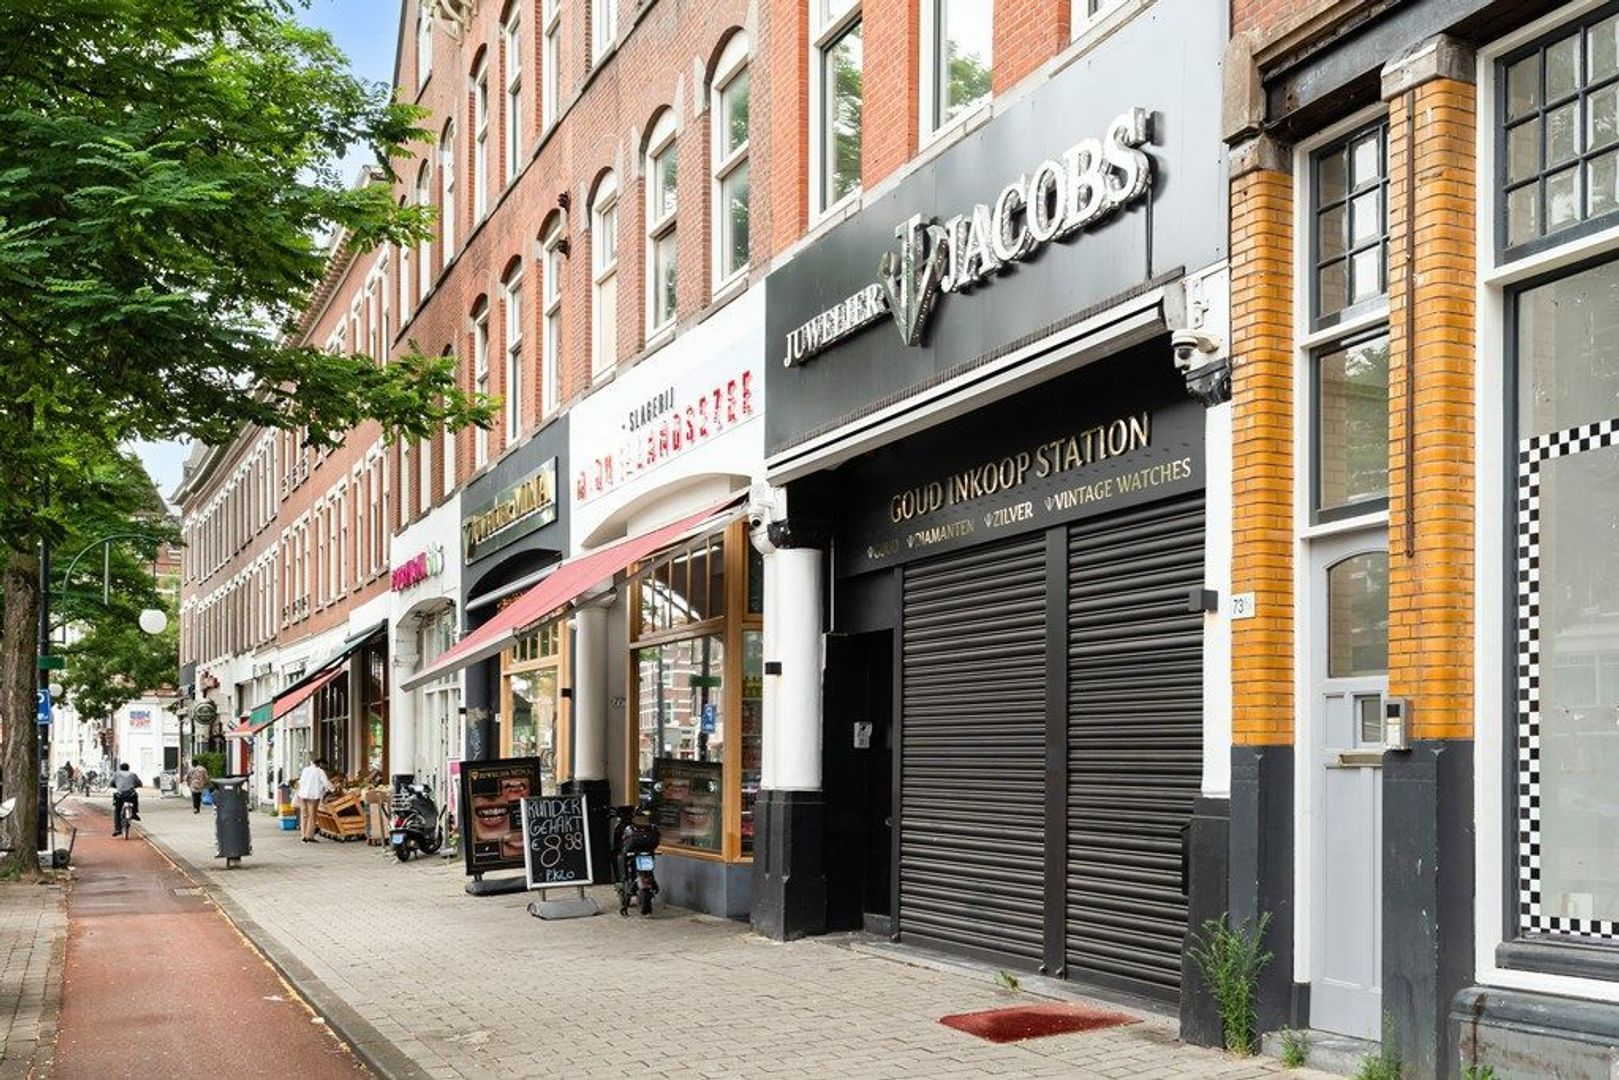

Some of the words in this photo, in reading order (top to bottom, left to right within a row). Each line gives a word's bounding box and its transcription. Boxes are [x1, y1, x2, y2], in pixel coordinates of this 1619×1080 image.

[783, 283, 889, 368] JUWELIER
[938, 105, 1153, 294] JACOBS
[629, 386, 675, 432] SLAGERIJ
[890, 481, 942, 523] GOUD
[948, 451, 1031, 505] INKOOP
[1035, 411, 1149, 479] STATION
[992, 500, 1034, 528] ZILVER
[1053, 478, 1113, 511] VINTAGE
[1115, 457, 1192, 494] WATCHES
[529, 815, 584, 836] GEHAKT
